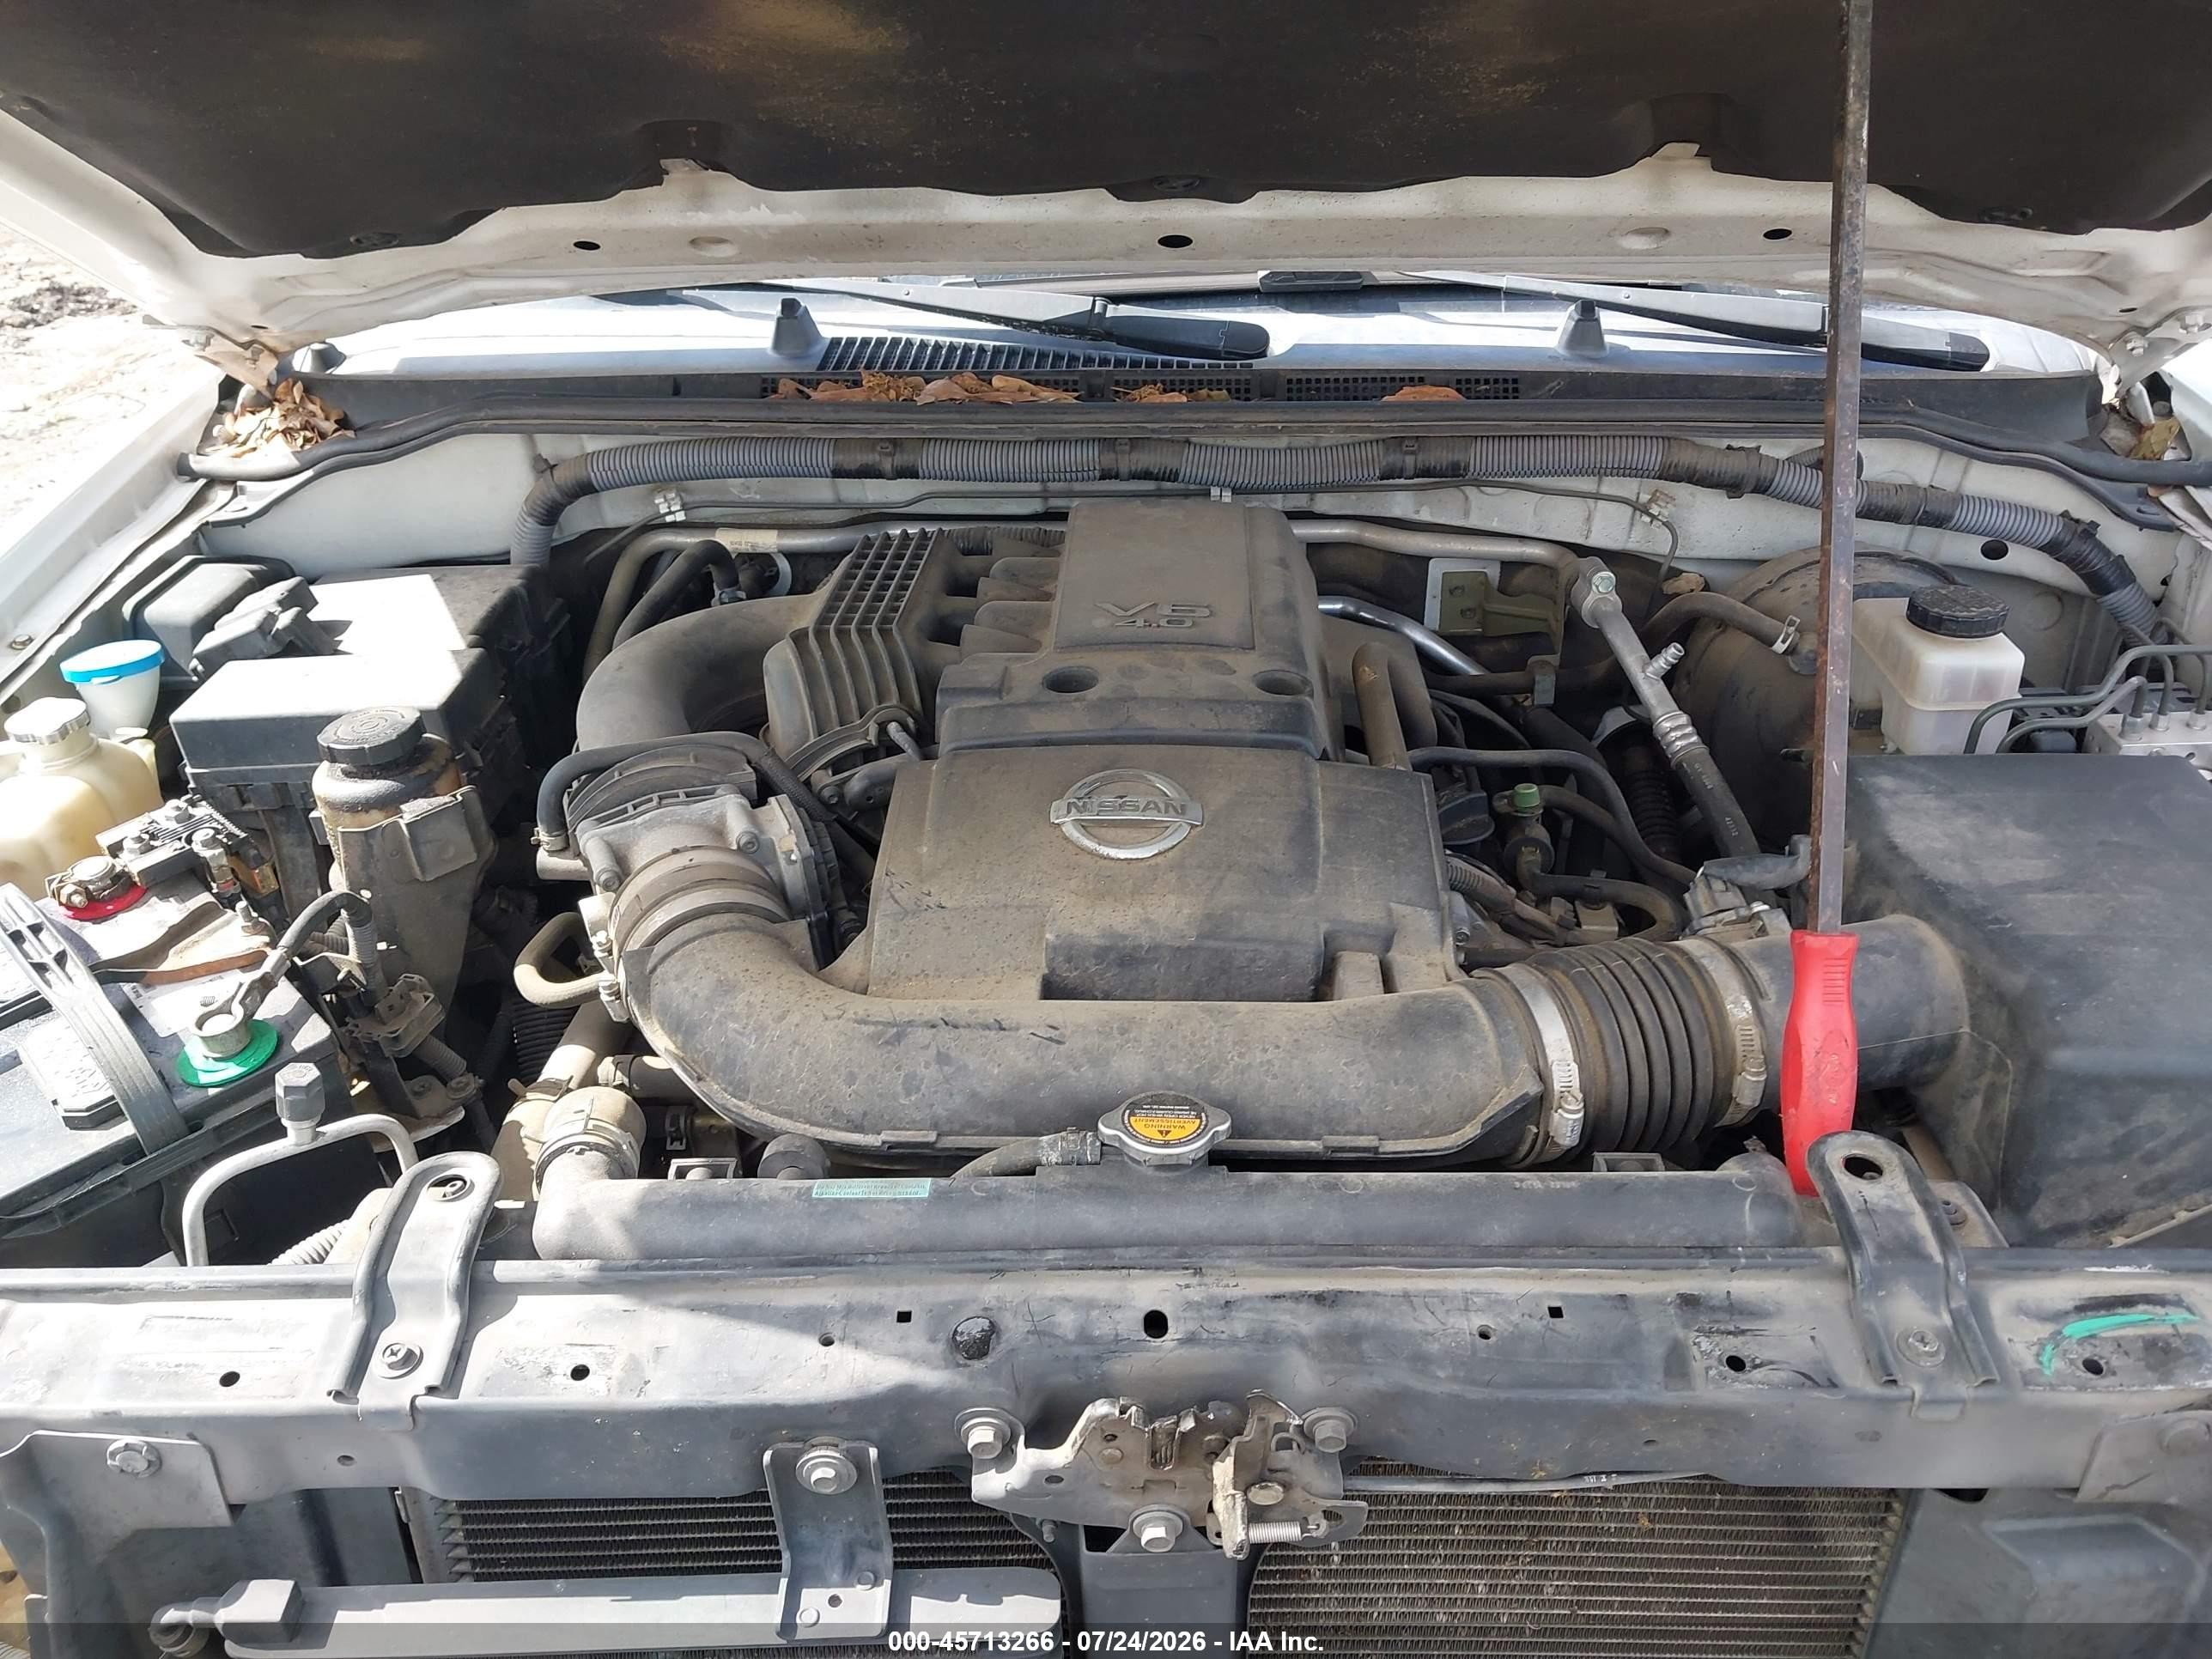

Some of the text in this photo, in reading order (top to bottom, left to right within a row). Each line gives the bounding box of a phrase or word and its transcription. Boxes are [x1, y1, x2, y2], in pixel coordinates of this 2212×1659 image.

[1093, 601, 1212, 618] V6
[1115, 617, 1195, 629] 4.0
[1066, 797, 1188, 816] NISSAN
